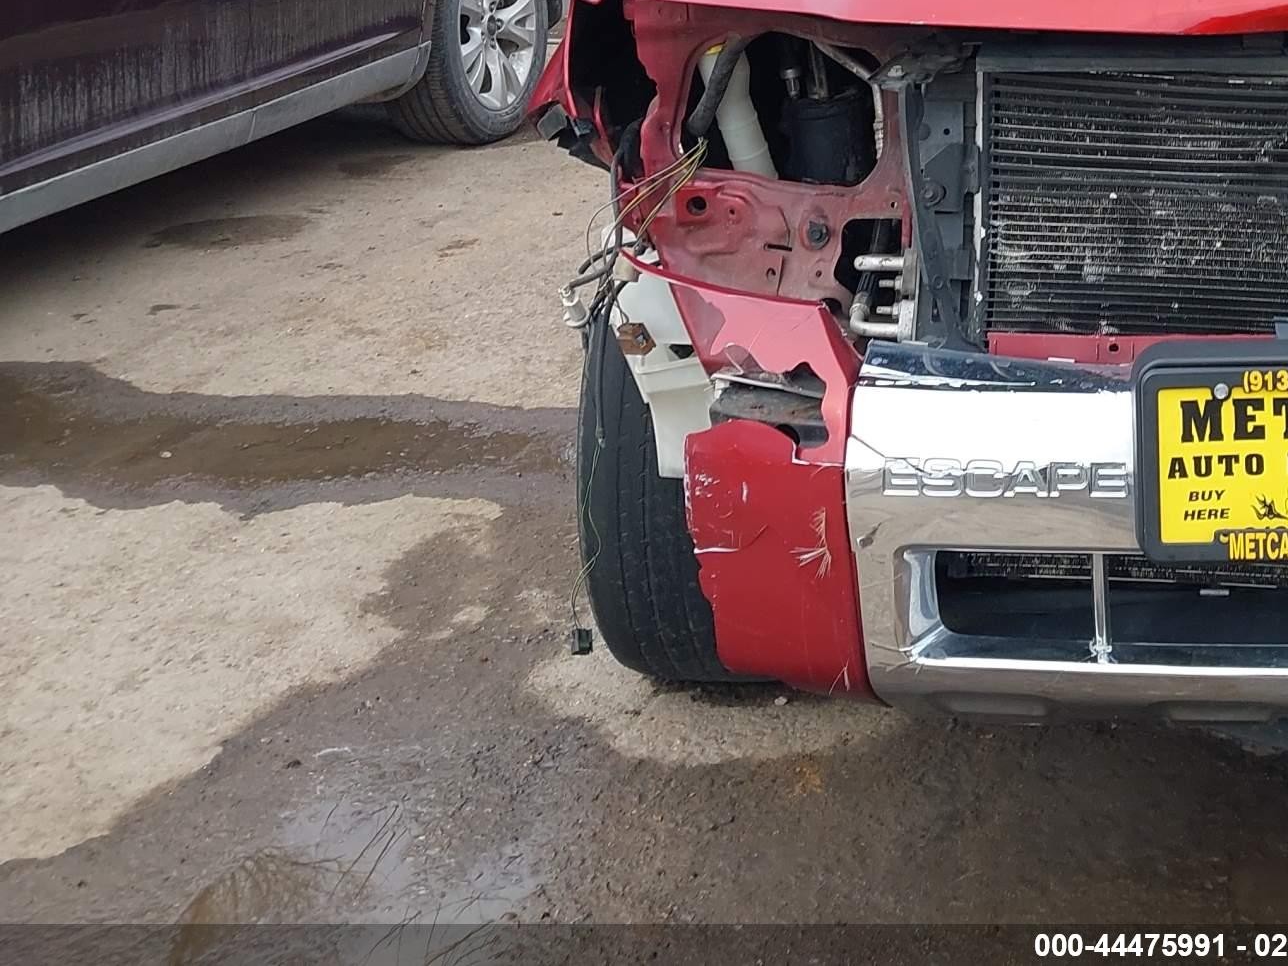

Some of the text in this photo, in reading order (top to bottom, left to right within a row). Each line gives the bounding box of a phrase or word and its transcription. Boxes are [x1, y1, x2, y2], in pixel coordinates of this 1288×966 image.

[1167, 453, 1265, 479] AUTO
[881, 456, 1129, 498] ESCAPE
[1188, 489, 1226, 502] BUY
[1183, 507, 1230, 521] HERE
